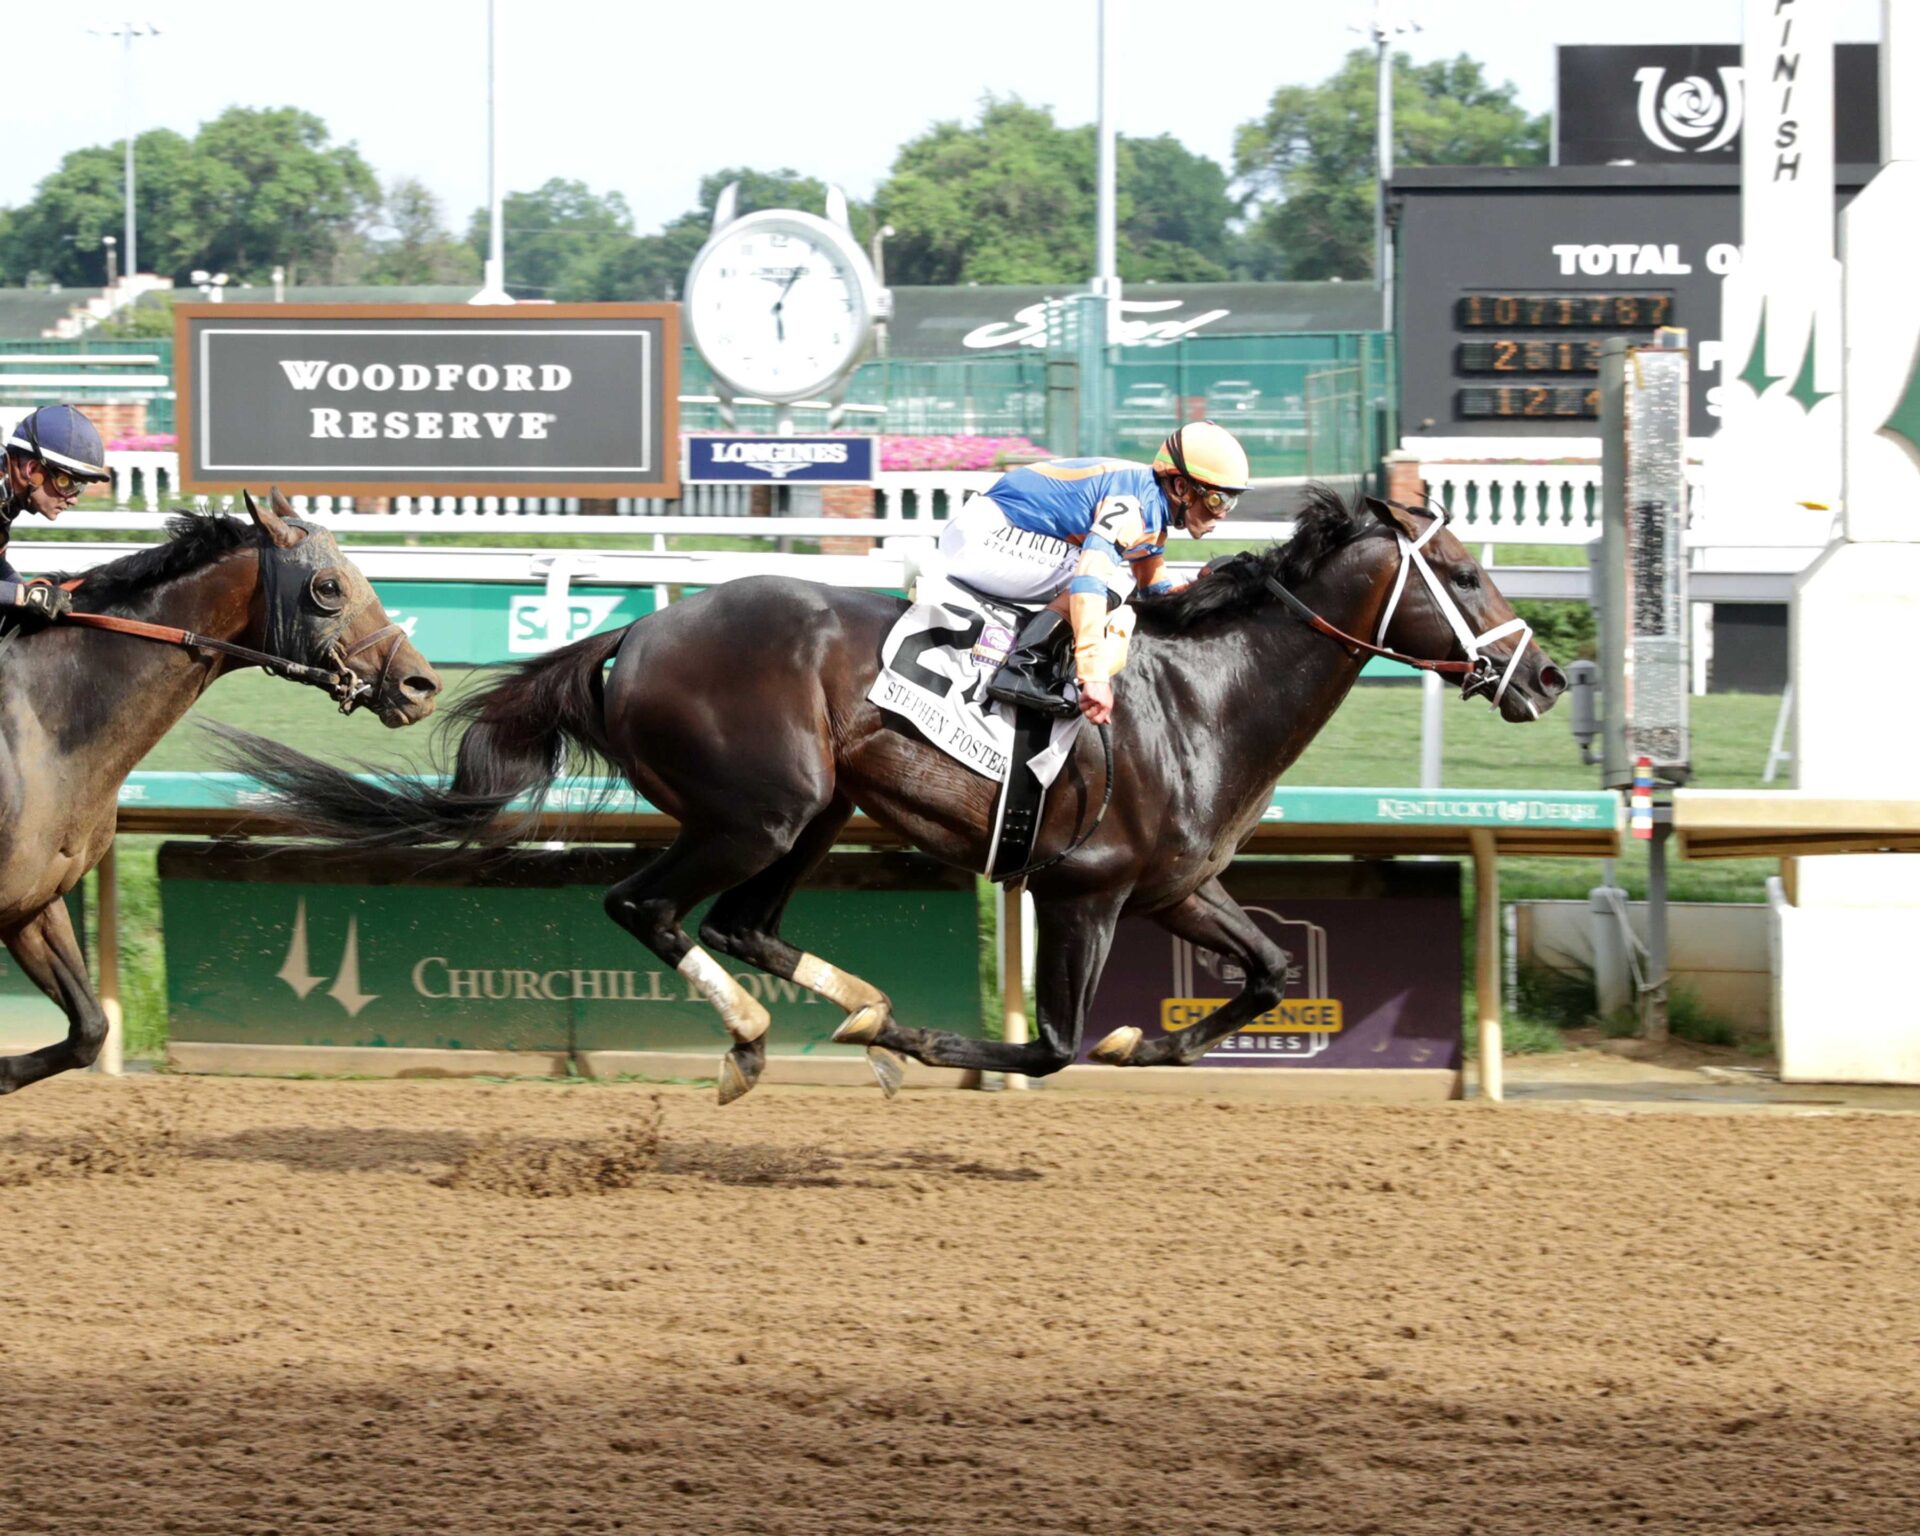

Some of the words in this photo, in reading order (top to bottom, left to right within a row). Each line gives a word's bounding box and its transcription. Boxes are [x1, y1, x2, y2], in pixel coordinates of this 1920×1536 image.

[1552, 244, 1692, 275] TOTAL
[279, 360, 572, 391] WOODFORD
[309, 408, 550, 439] RESERVE
[711, 443, 848, 463] LONGINES
[1098, 502, 1129, 531] 2
[983, 538, 1076, 573] STEAKHOUSE
[516, 606, 592, 641] SP
[889, 602, 986, 699] 2
[884, 681, 949, 736] STEPHEN
[948, 727, 1008, 776] FOSTER
[1376, 798, 1498, 819] KENTUCKY
[412, 957, 676, 1000] CHURCHILL
[1168, 1005, 1335, 1026] CHENGE
[1213, 1036, 1302, 1050] ERIES
